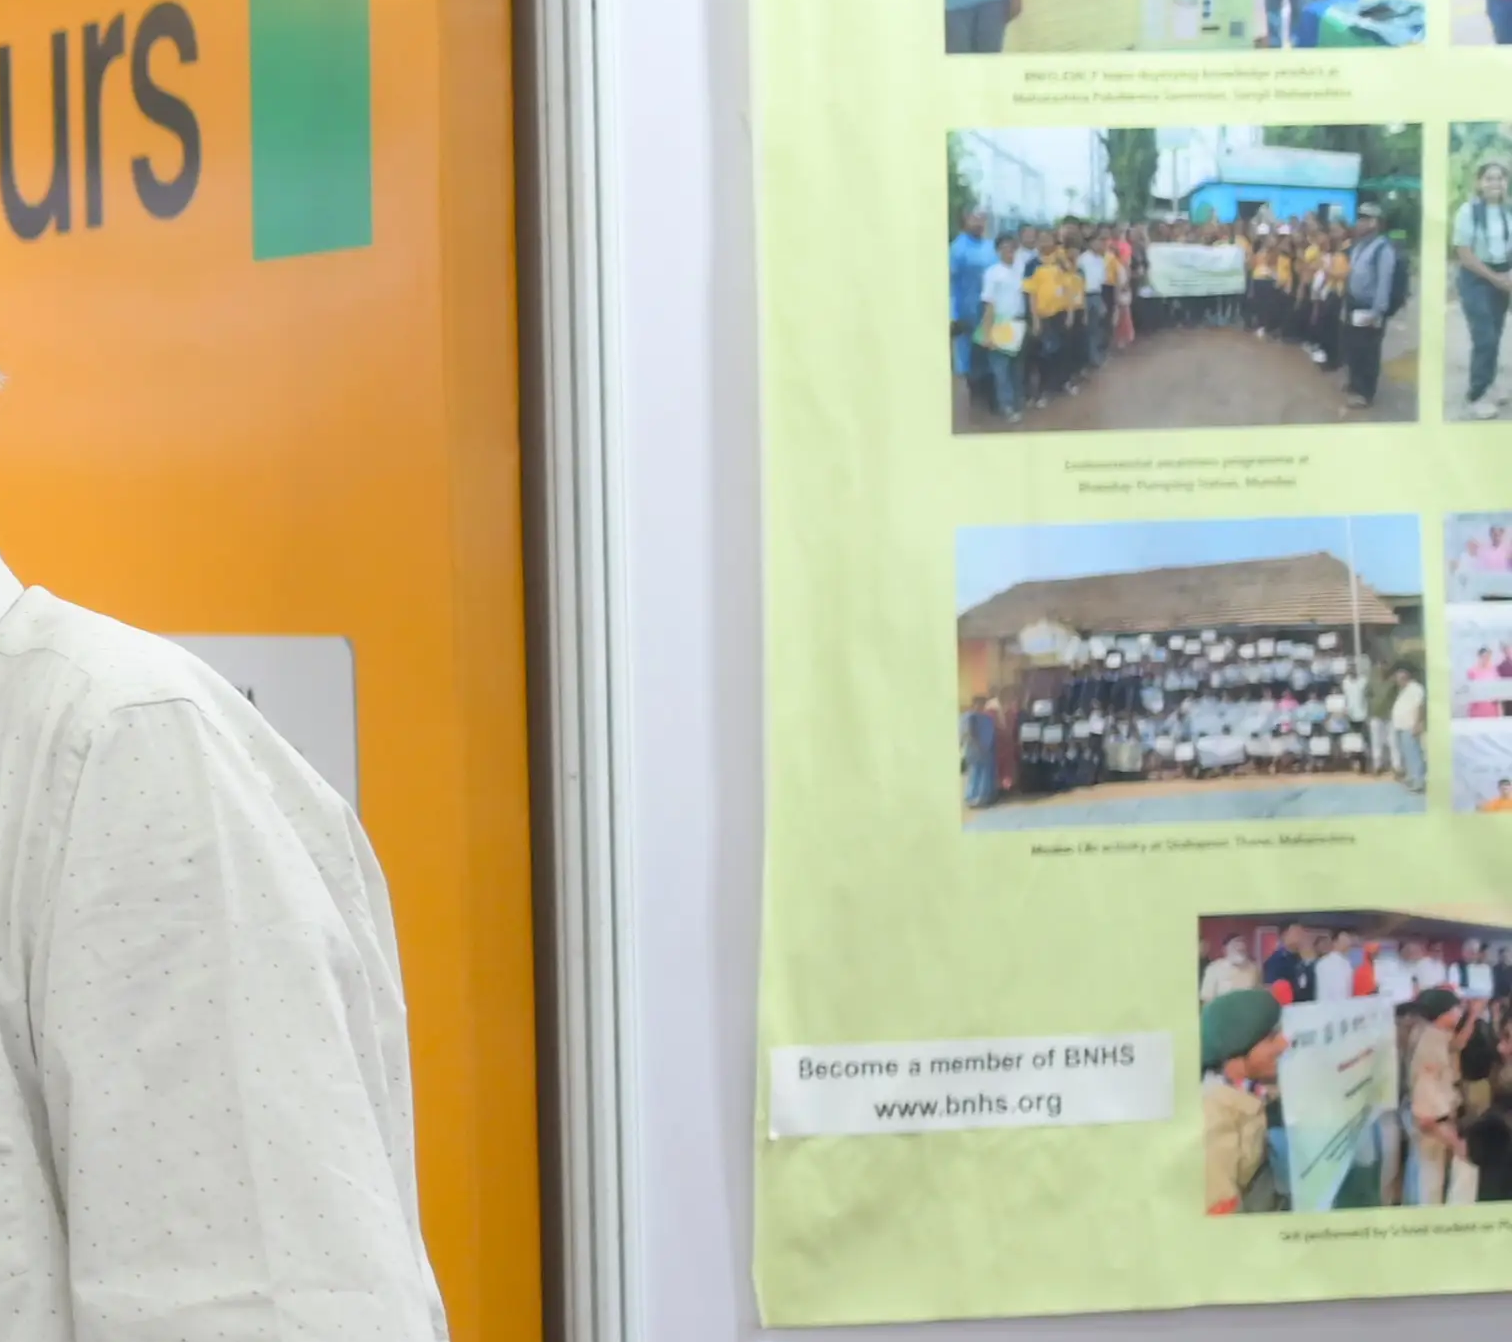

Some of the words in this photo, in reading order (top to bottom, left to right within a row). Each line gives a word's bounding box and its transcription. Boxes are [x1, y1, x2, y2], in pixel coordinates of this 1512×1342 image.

[798, 1056, 899, 1080] Become
[908, 1060, 921, 1077] a
[930, 1049, 1023, 1075] member
[1032, 1048, 1057, 1070] of
[1064, 1043, 1136, 1069] BNHS
[874, 1091, 1063, 1120] www.bnhs.org
